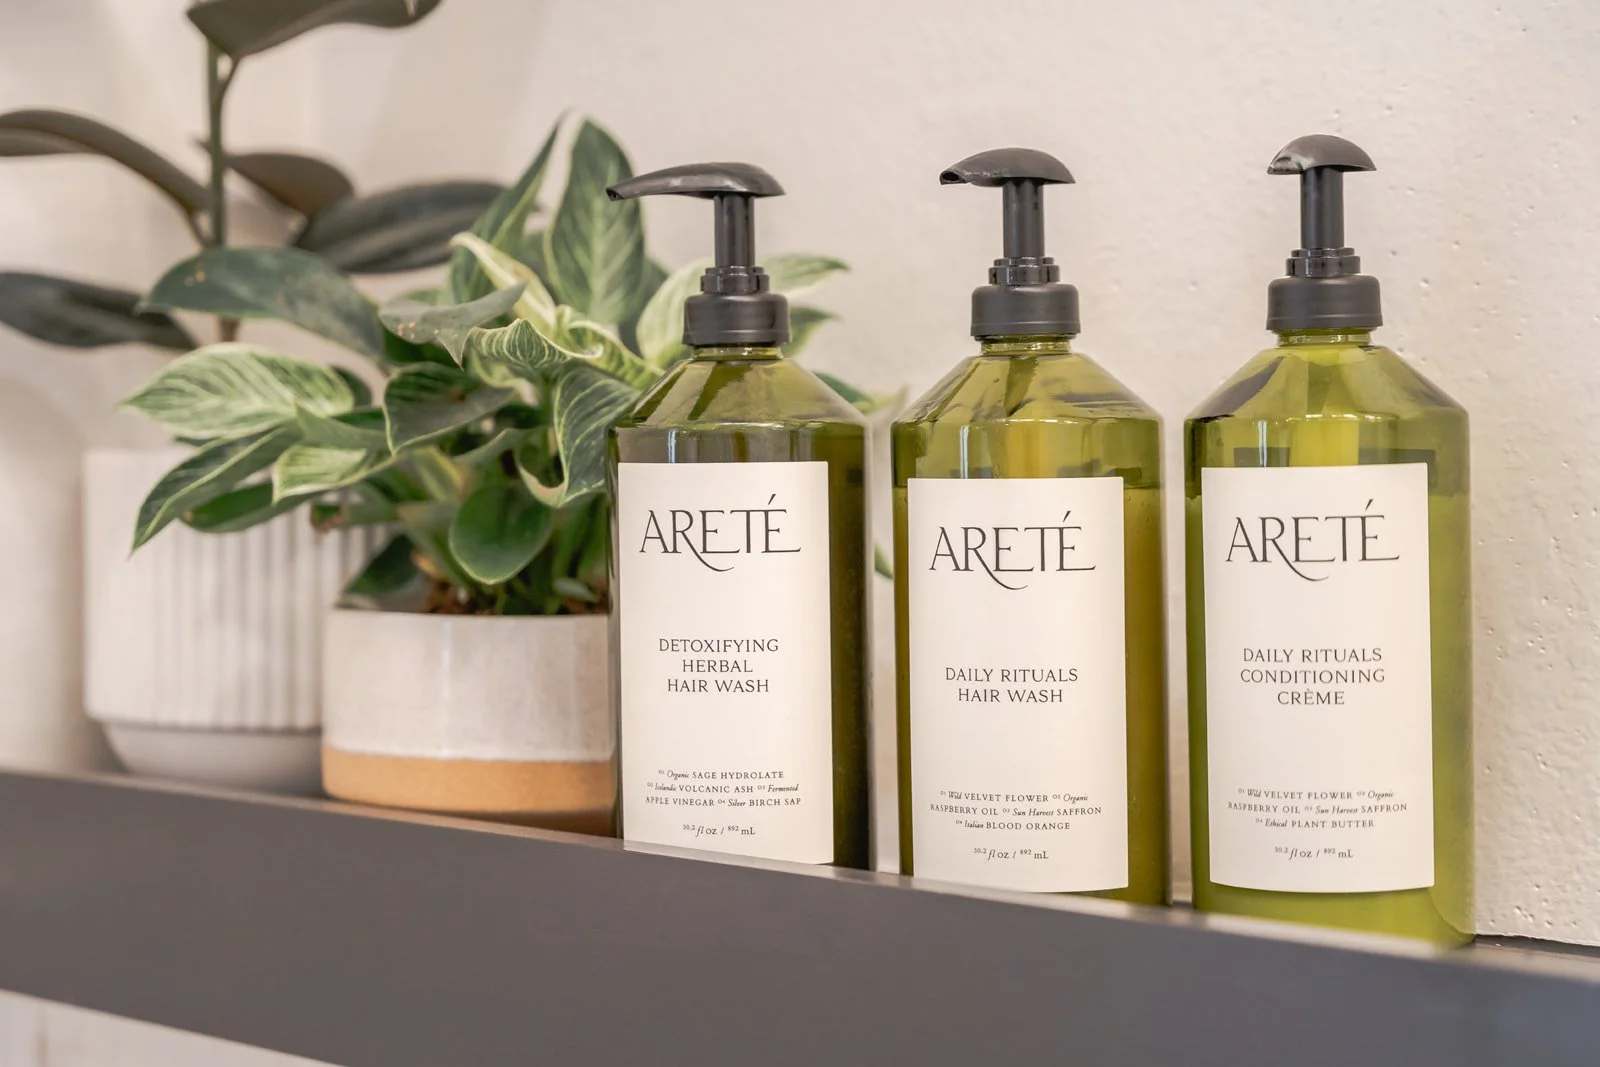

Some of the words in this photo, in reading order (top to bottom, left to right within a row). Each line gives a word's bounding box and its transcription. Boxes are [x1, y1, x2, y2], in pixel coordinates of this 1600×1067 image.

[639, 494, 802, 572] ARETÉ
[1225, 498, 1401, 582] ARETÉ
[928, 510, 1097, 590] ARETÉ
[658, 638, 779, 653] DETOXIFYING
[1243, 648, 1293, 663] DAILY
[1301, 648, 1382, 663] RITUALS
[682, 658, 754, 673] HERBAL
[945, 667, 993, 682] DAILY
[1001, 668, 1078, 683] RITUALS
[1240, 669, 1385, 684] CONDITIONING
[667, 678, 709, 693] HAIR
[713, 678, 769, 693] WASH
[958, 688, 1000, 702] HAIR
[1006, 688, 1064, 703] WASH
[1277, 688, 1345, 706] CRÈME
[667, 770, 689, 780] Organic
[693, 771, 717, 779] SAGE
[720, 771, 784, 779] HYDROLATE
[679, 784, 730, 793] VOLCANIC
[768, 784, 800, 792] Fermented
[1247, 789, 1261, 798] Wild
[1264, 791, 1303, 799] VELVET
[1368, 790, 1394, 801] Organic
[646, 796, 669, 805] APPLE
[672, 798, 715, 806] VINEGAR
[728, 799, 746, 807] Silver
[948, 791, 961, 800] Wild
[964, 793, 1001, 801] VELVET
[1005, 794, 1048, 802] FLOWER
[1063, 793, 1088, 804] Organic
[930, 804, 977, 815] RASPBERRY
[1013, 808, 1025, 816] Sun
[1029, 808, 1054, 816] Harvest
[1057, 807, 1101, 816] SAFFRON
[1228, 802, 1278, 813] RASPBERRY
[1282, 806, 1300, 814] OIL
[1315, 806, 1329, 814] Sun
[1332, 806, 1358, 814] Harvest
[1361, 803, 1407, 813] SAFFRON
[964, 820, 984, 828] Italian
[986, 822, 1022, 830] BLOOD
[1026, 822, 1070, 830] ORANGE
[1265, 819, 1287, 828] Ethical
[1292, 820, 1326, 828] PLANT
[1331, 820, 1374, 828] BUTTER
[741, 827, 756, 835] mL
[1034, 851, 1048, 859] mL
[1300, 850, 1312, 858] oz
[1338, 850, 1354, 858] mL
